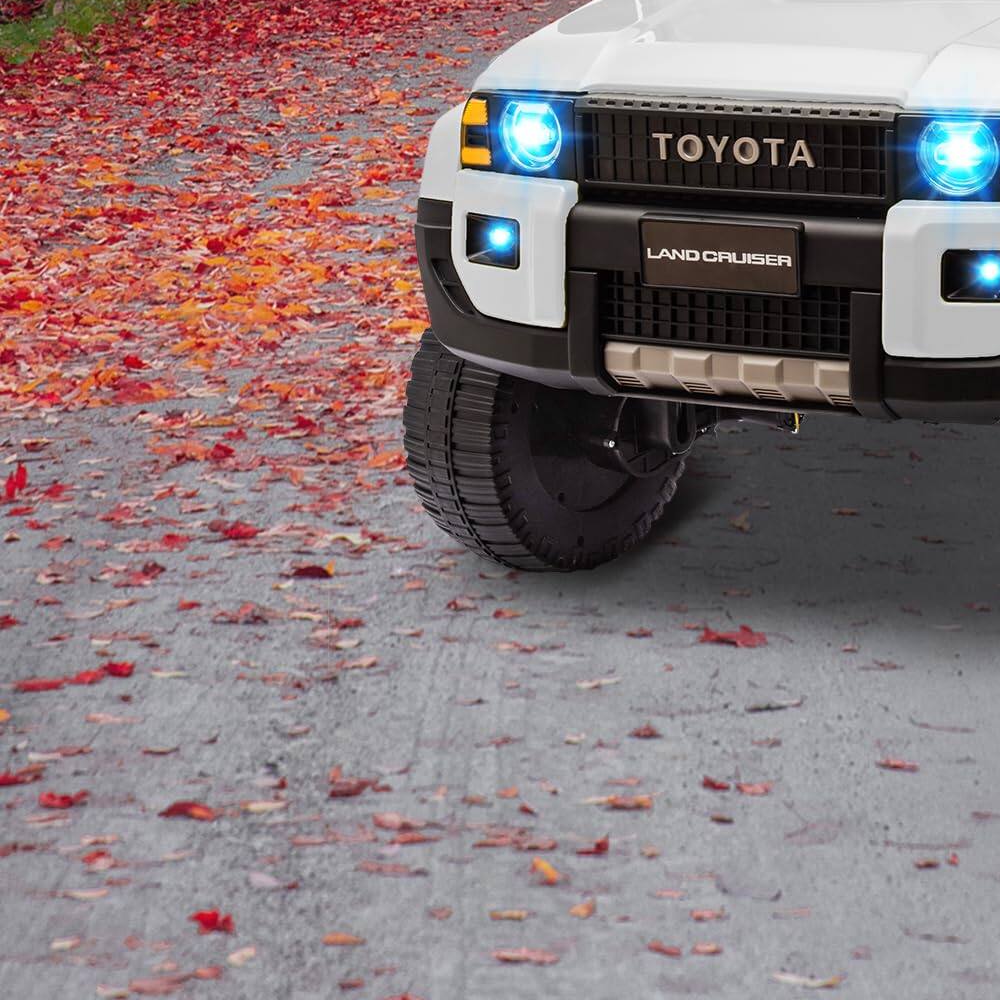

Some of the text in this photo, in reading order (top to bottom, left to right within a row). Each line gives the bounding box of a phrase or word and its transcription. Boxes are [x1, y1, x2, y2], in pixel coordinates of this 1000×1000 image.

[652, 132, 816, 168] TOYOTA
[646, 247, 792, 267] LAND CRUISER
